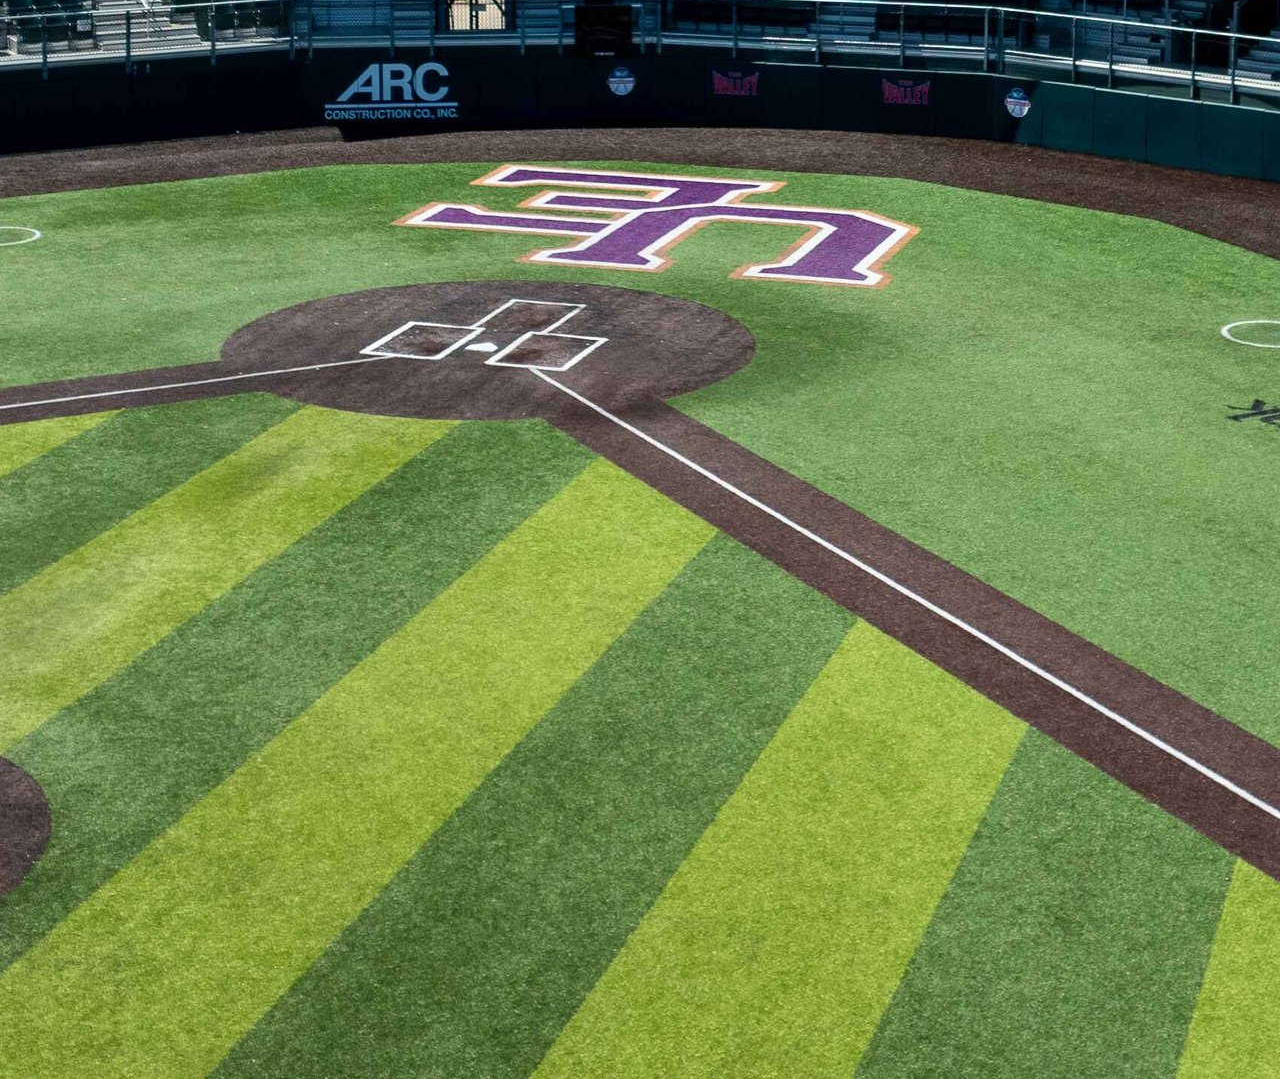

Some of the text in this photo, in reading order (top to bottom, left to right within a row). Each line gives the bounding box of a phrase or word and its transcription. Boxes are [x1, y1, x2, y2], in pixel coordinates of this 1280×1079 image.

[335, 62, 449, 102] ARC
[712, 71, 759, 95] VALLEY
[882, 78, 931, 105] VALLEY
[324, 109, 411, 120] CONSTRUCTION
[437, 108, 458, 118] INC.
